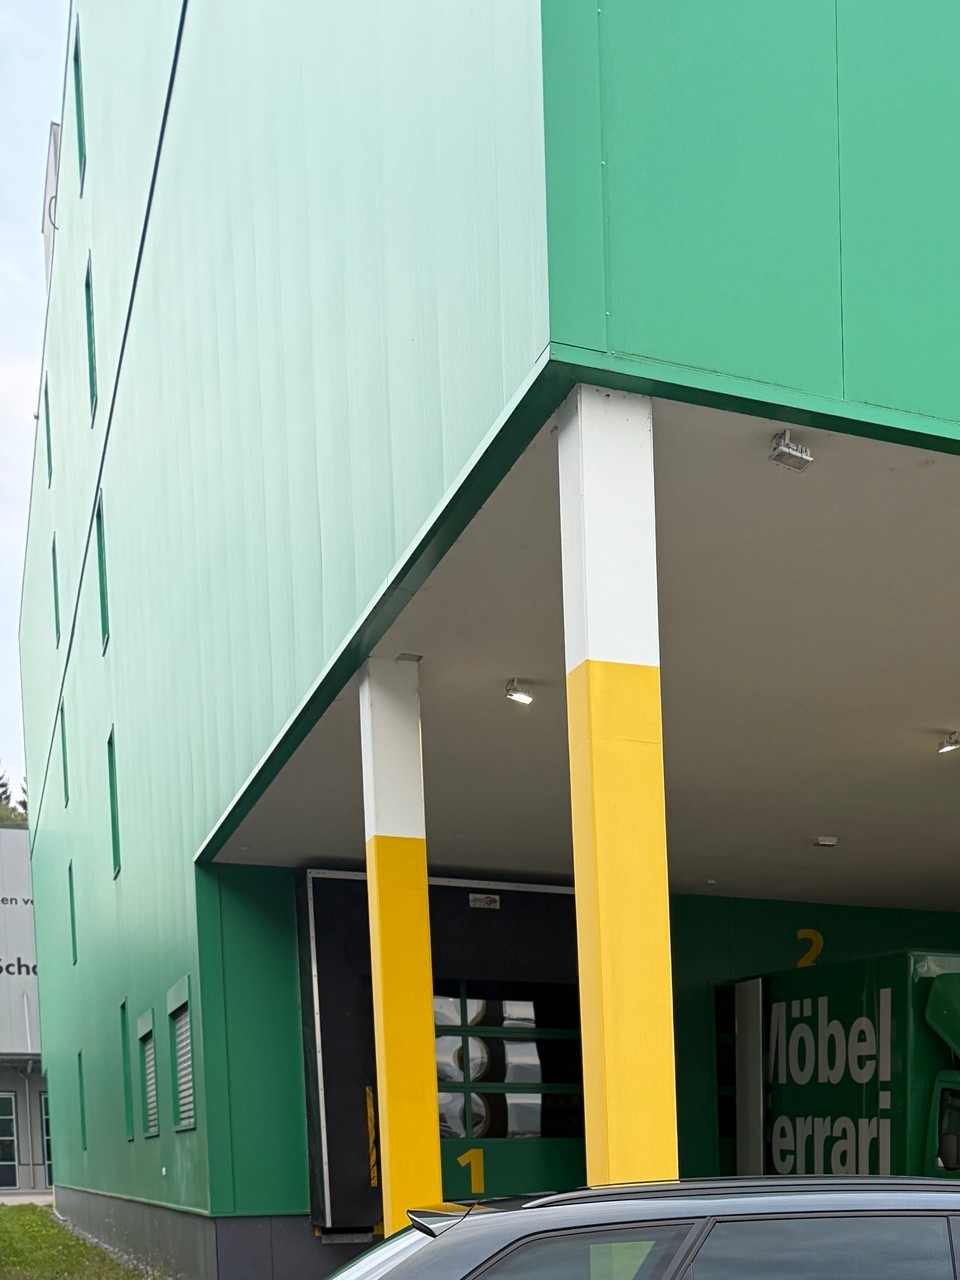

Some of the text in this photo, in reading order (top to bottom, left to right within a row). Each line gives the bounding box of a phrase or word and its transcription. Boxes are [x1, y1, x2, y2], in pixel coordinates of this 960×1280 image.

[797, 928, 824, 968] 2
[767, 1091, 891, 1176] errari
[456, 1148, 485, 1194] 1
